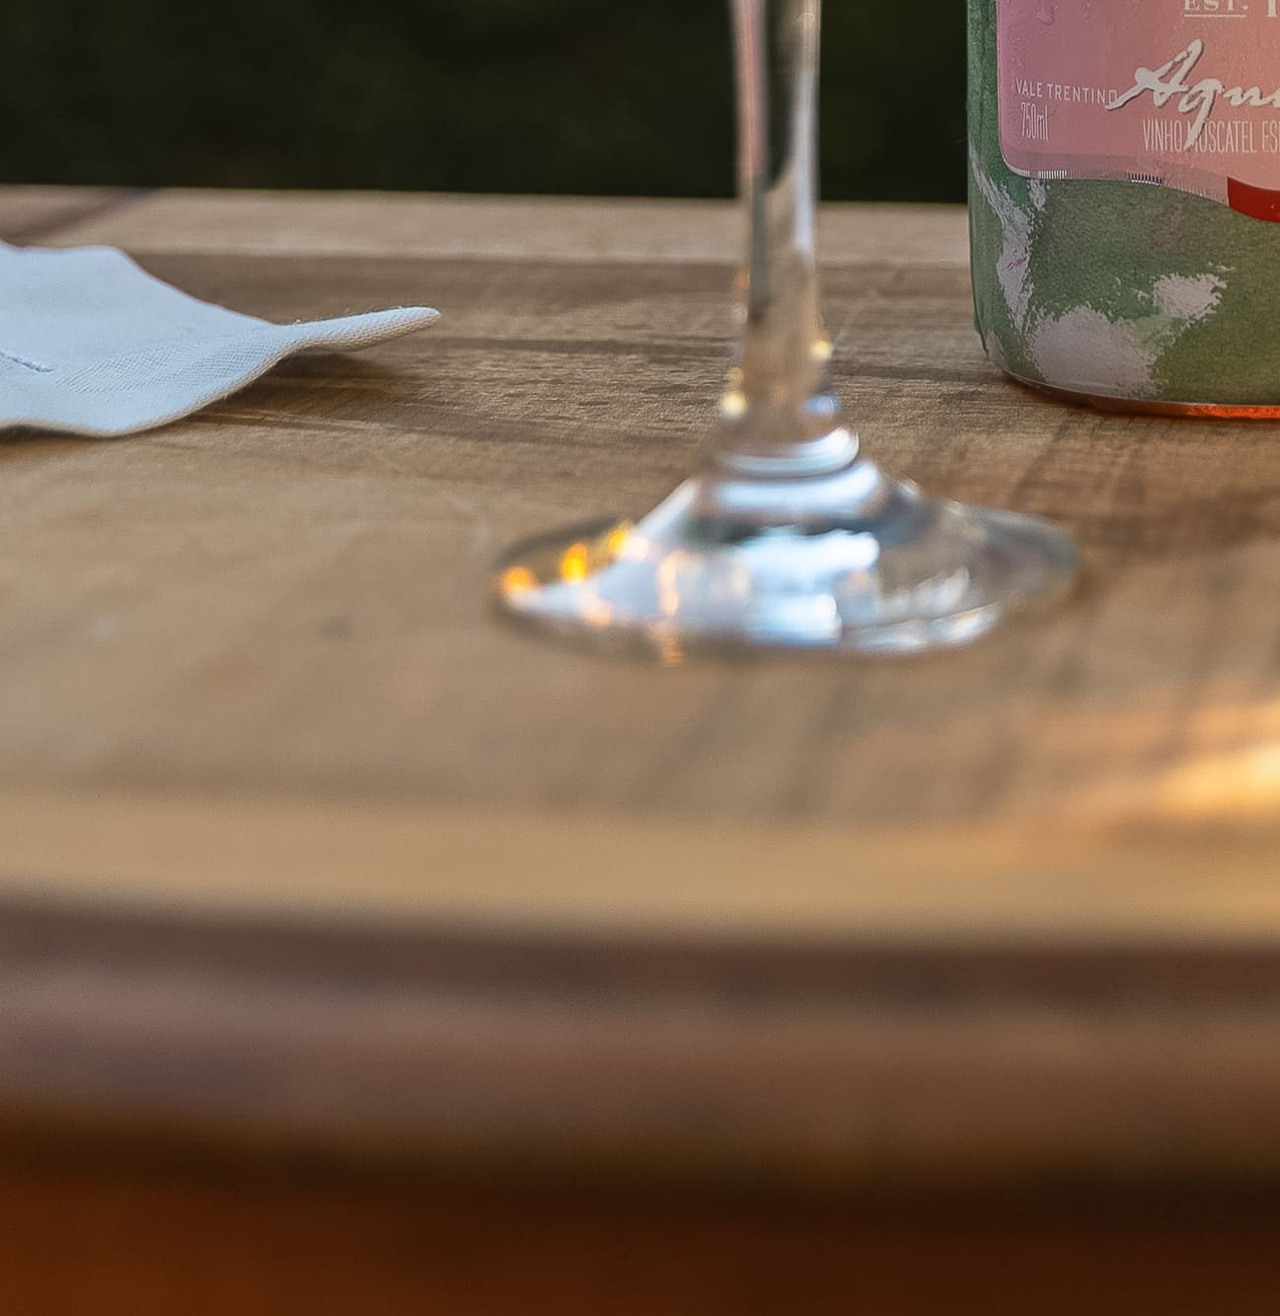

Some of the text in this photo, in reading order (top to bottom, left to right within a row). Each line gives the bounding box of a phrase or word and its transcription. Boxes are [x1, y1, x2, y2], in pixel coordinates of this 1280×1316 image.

[1015, 77, 1118, 105] VALE TRENTINO
[1019, 100, 1050, 142] 750ml
[1142, 118, 1186, 153] VINHO
